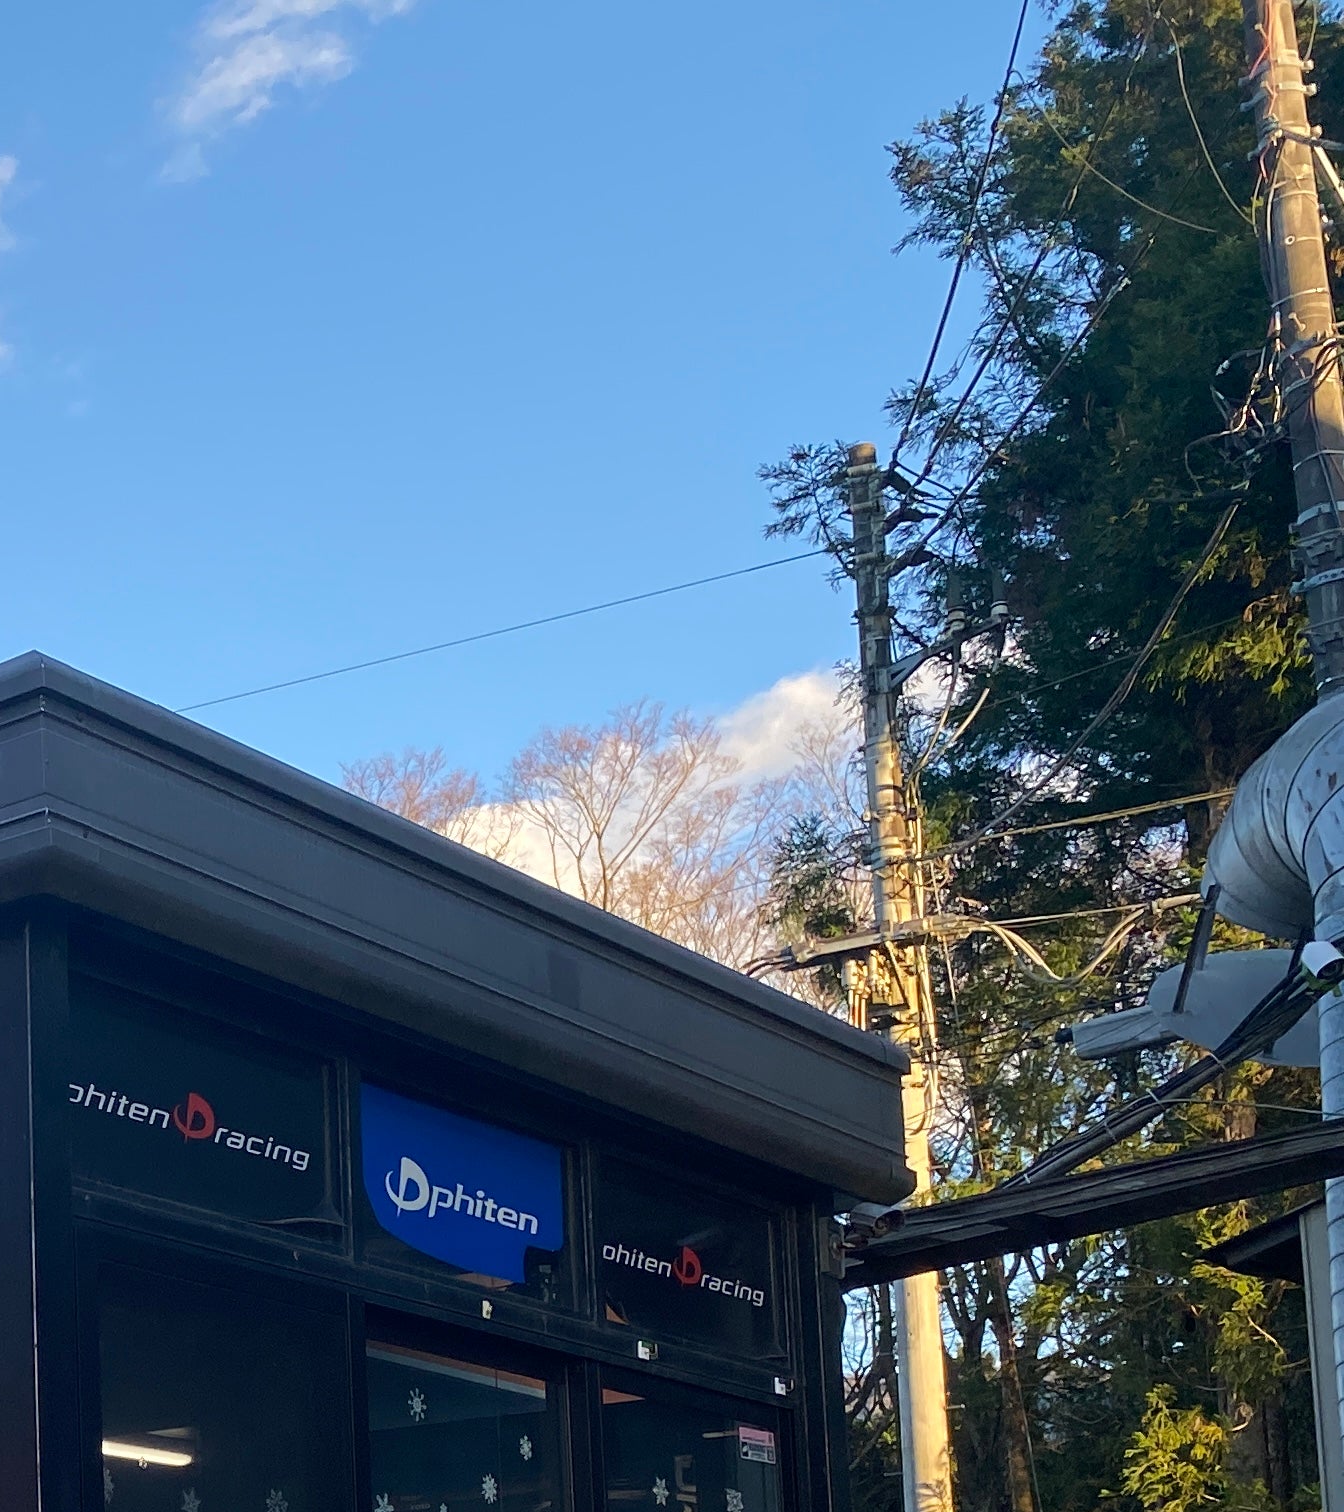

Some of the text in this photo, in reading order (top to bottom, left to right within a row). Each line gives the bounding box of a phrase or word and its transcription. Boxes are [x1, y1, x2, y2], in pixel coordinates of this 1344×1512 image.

[214, 1126, 310, 1171] racing
[427, 1187, 539, 1236] phiten
[700, 1273, 764, 1307] racing
